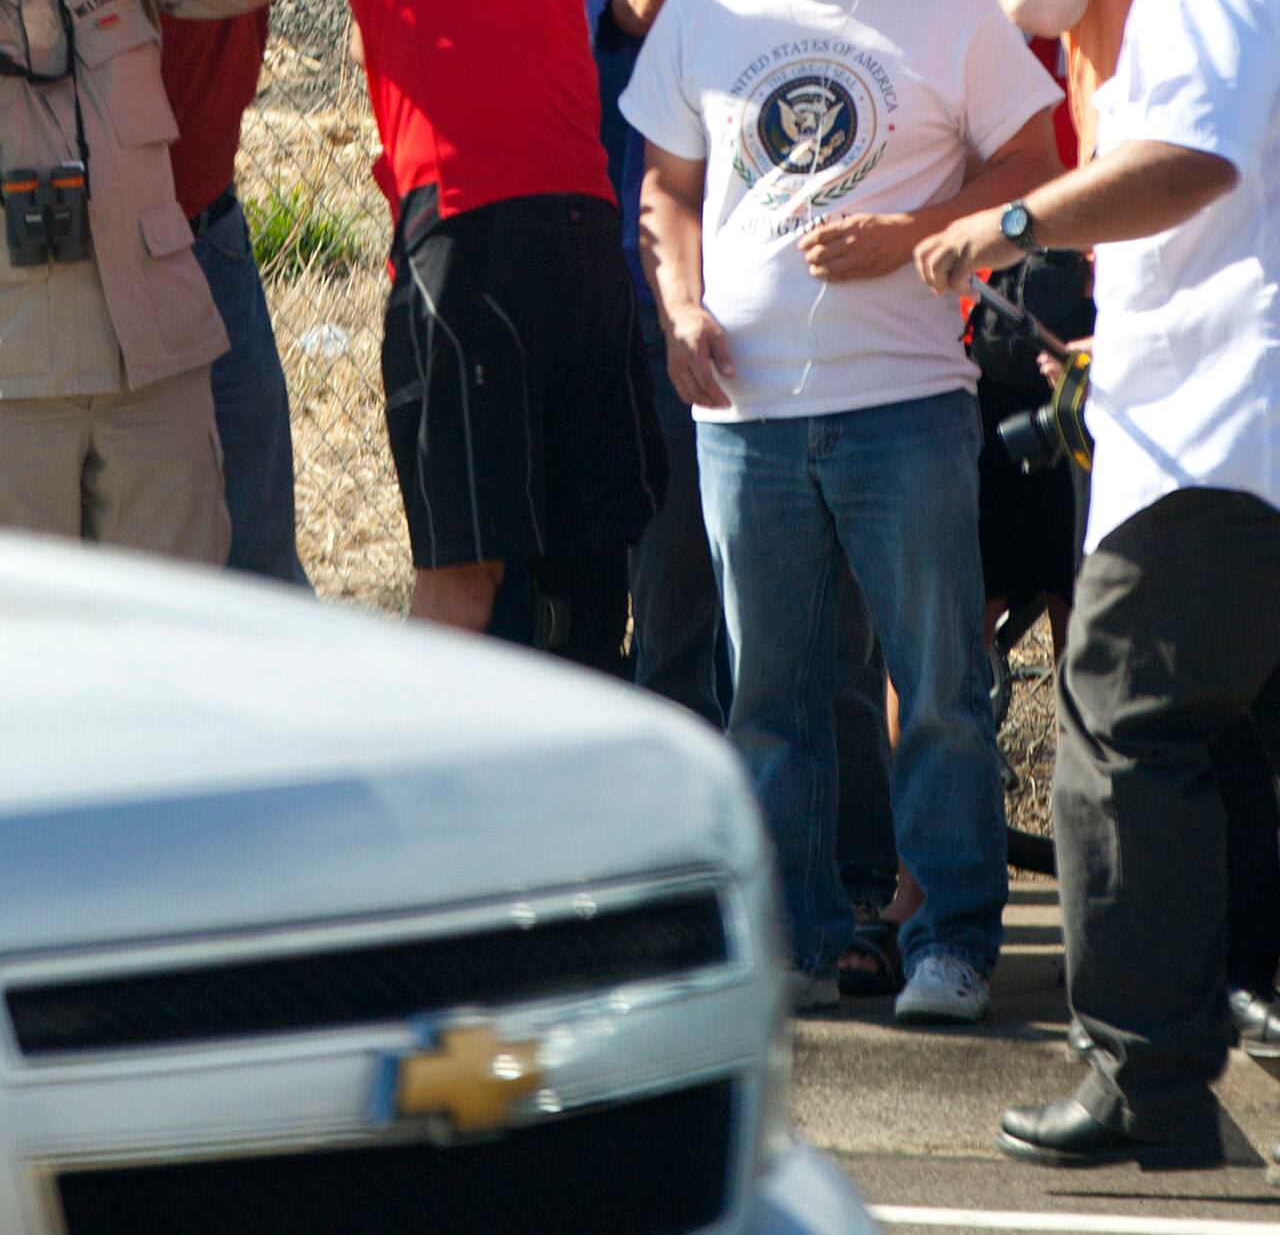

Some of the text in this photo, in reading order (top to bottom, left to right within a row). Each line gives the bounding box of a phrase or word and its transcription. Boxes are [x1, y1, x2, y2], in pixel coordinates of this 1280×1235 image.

[771, 38, 830, 62] STATES
[832, 40, 856, 57] OF
[853, 51, 899, 114] AMERICA
